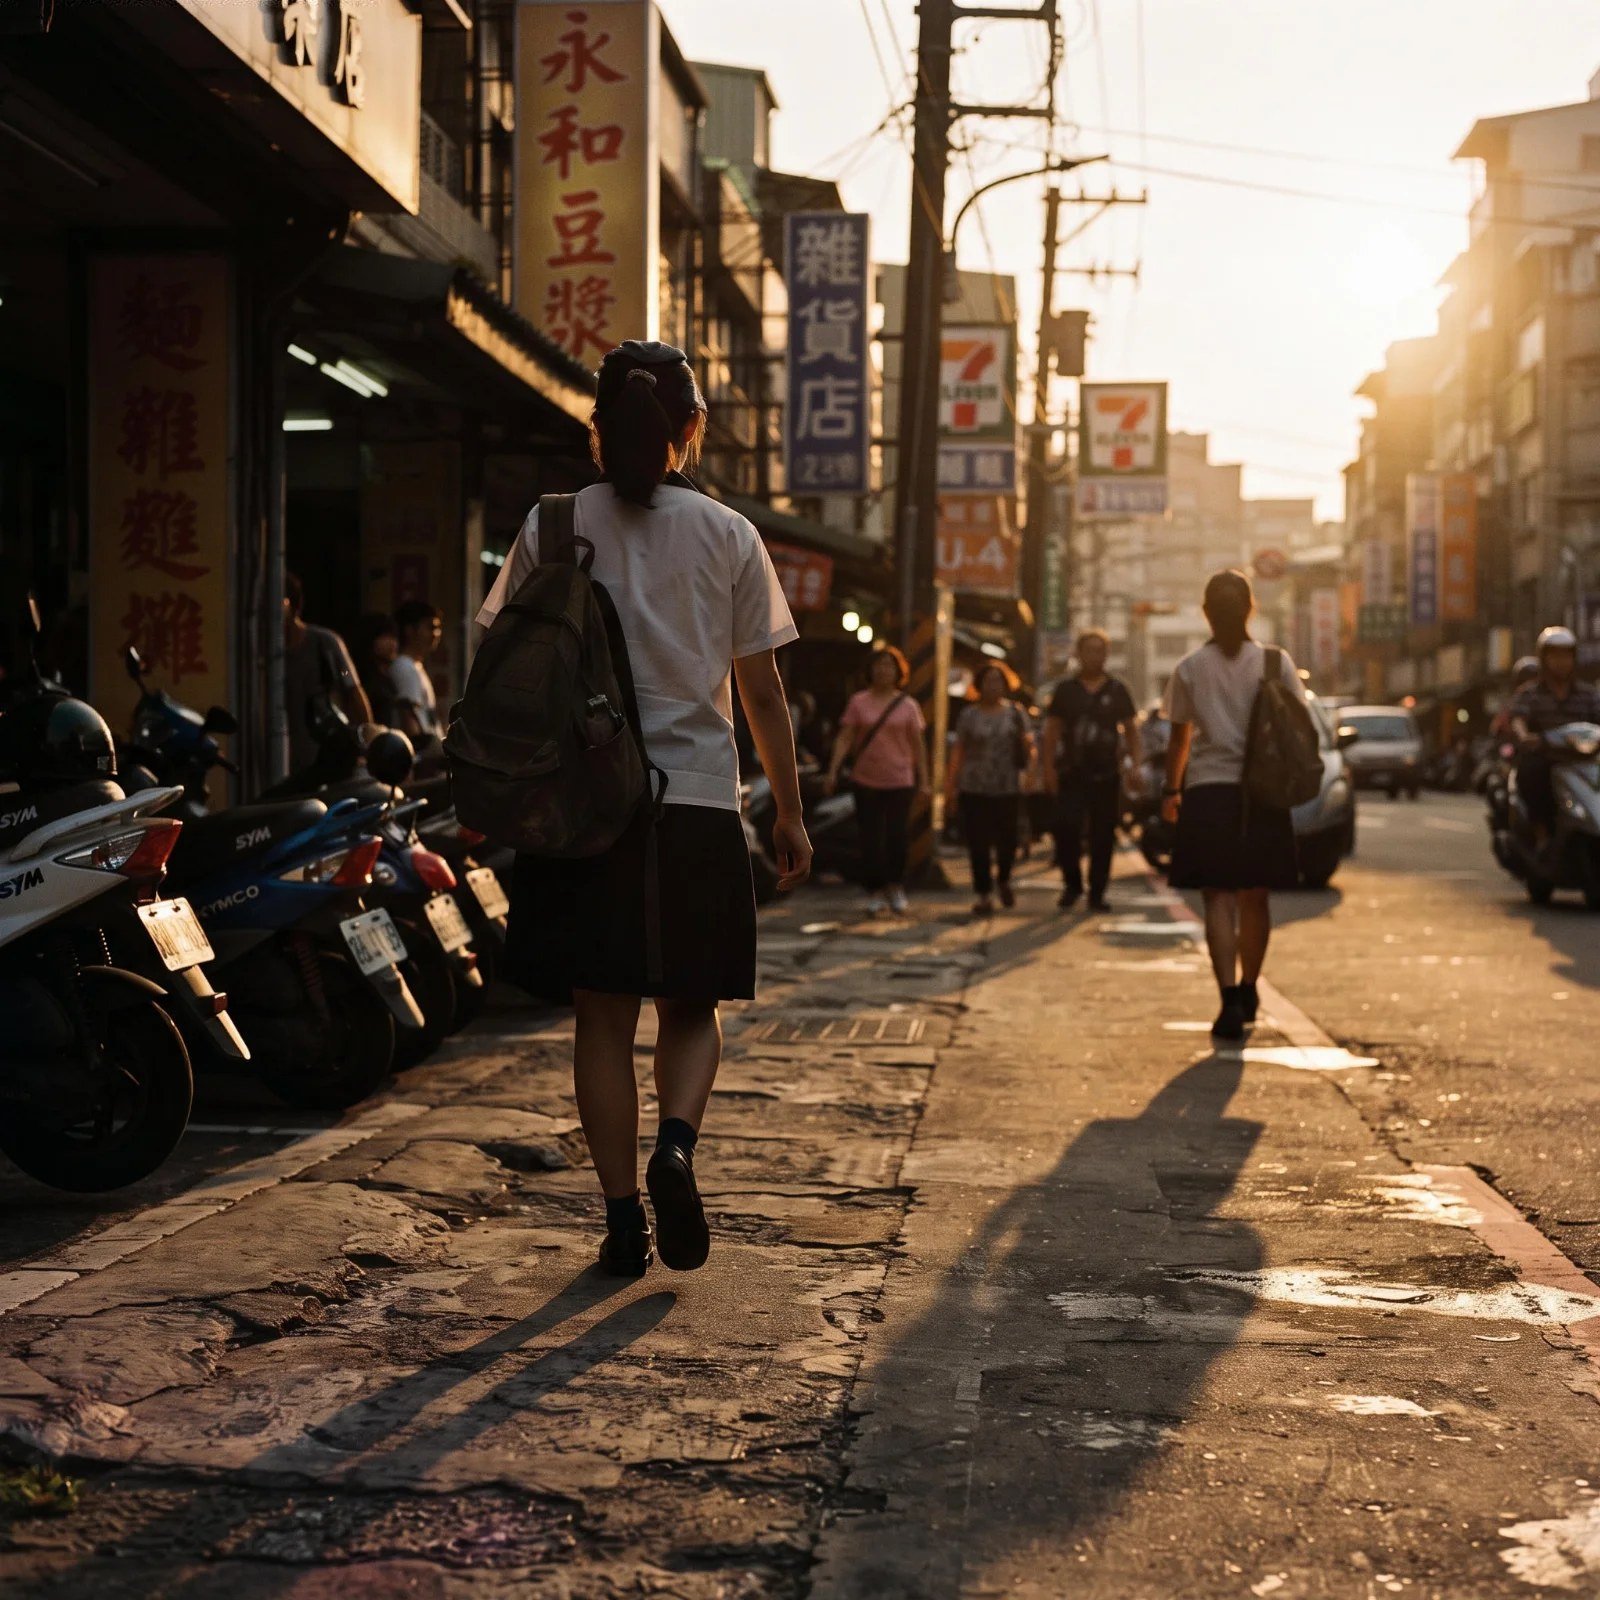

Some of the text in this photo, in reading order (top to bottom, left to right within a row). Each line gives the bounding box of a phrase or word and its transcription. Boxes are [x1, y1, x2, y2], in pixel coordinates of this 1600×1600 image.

[796, 221, 861, 441] 雜貨店
[1096, 395, 1149, 431] 7
[0, 803, 39, 829] SYM
[234, 825, 273, 851] SYM
[0, 866, 45, 899] SYM
